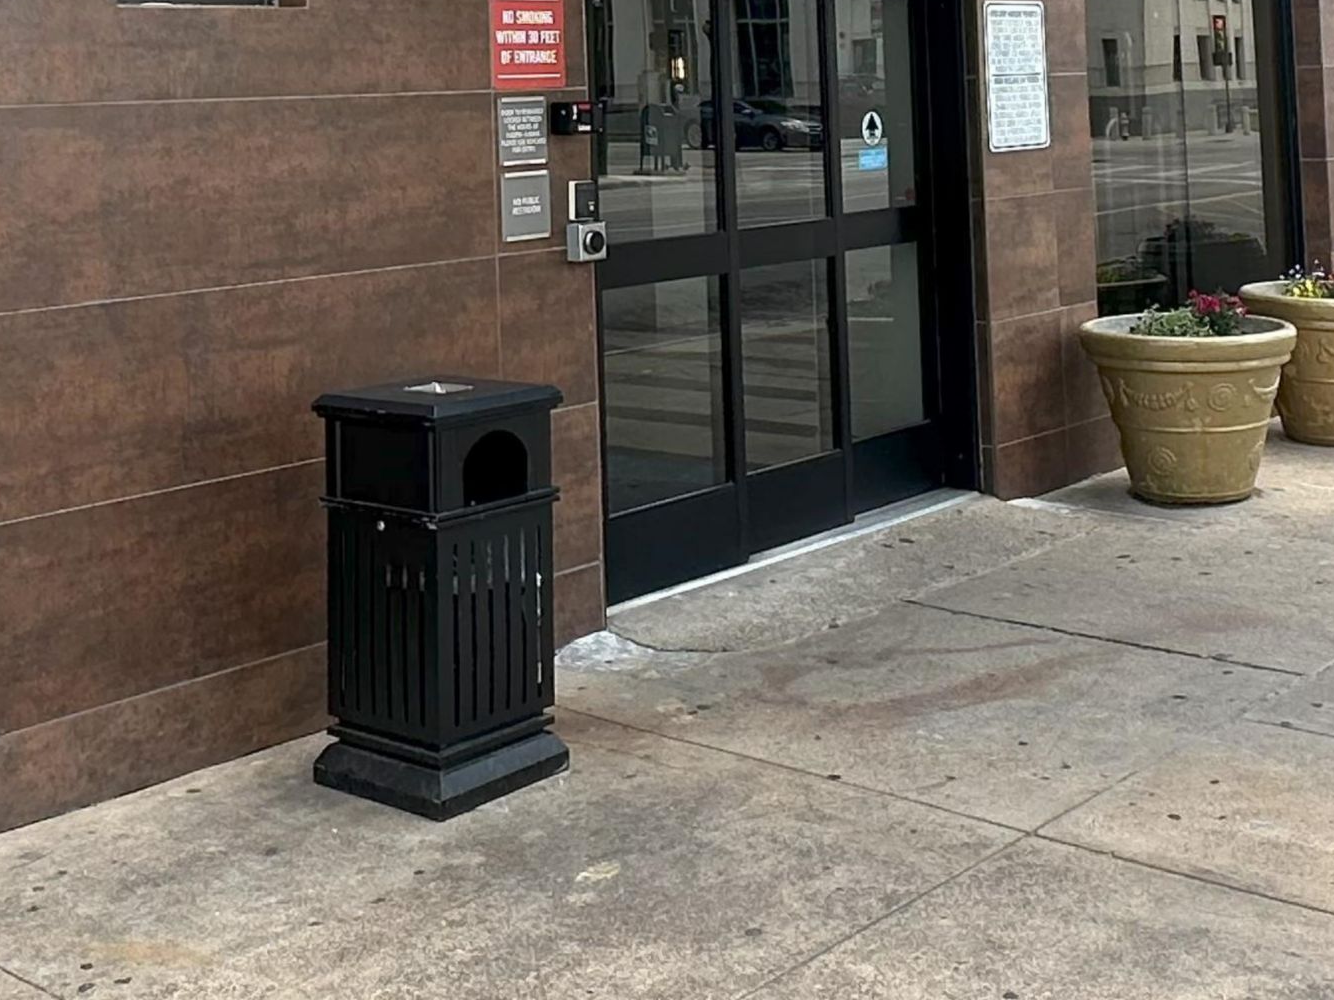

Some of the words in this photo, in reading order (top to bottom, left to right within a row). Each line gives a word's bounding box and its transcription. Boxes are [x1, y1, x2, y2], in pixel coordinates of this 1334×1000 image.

[502, 10, 514, 25] NO
[515, 10, 555, 25] SMOKING
[495, 30, 527, 44] WITHIN
[539, 30, 561, 44] FEET
[500, 50, 513, 65] OF
[514, 50, 558, 64] ENTRANCE
